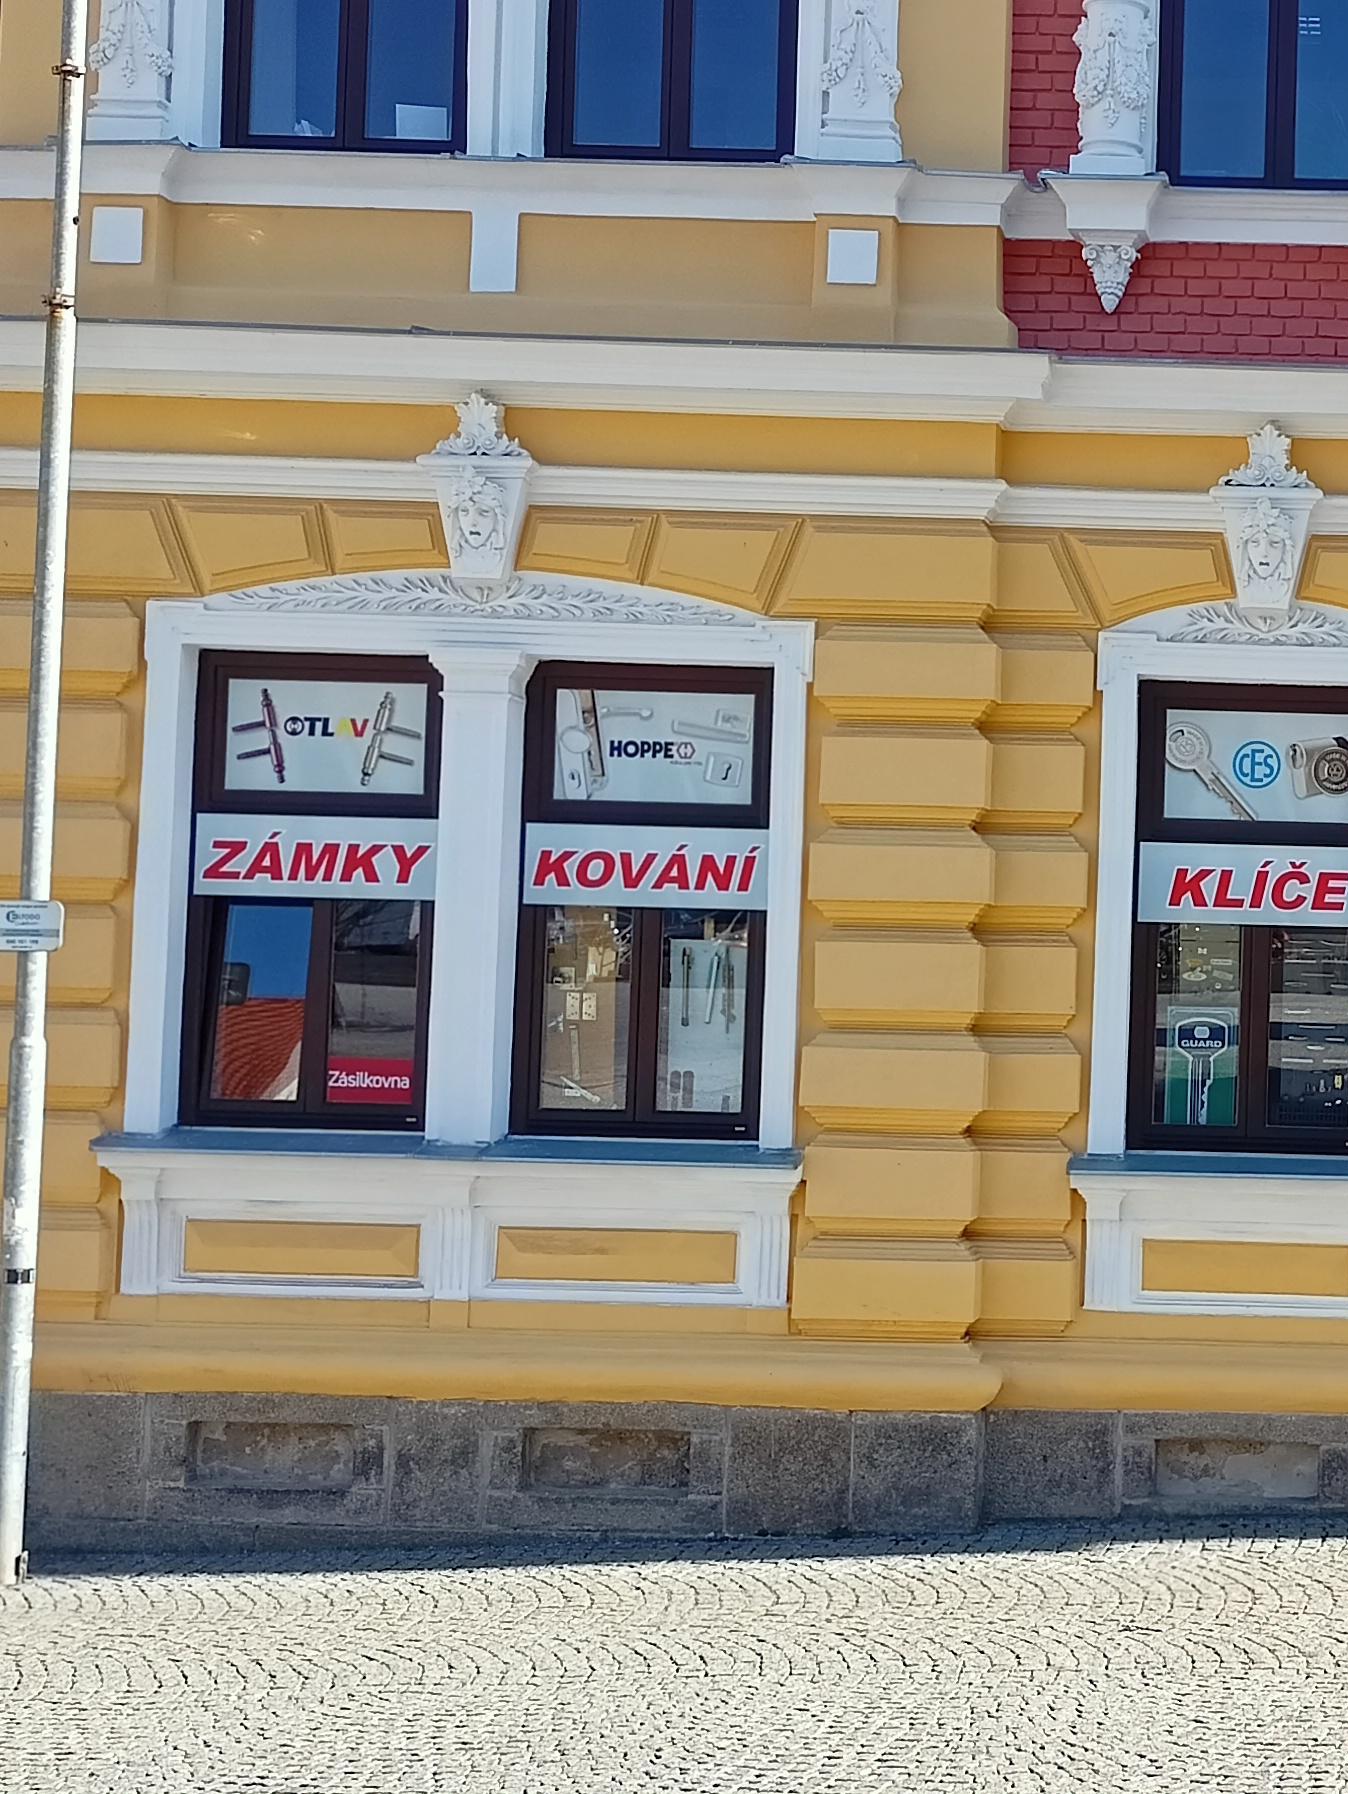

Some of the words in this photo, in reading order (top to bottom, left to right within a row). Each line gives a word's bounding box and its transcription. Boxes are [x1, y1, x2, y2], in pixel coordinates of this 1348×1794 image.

[283, 715, 370, 738] OTLAV
[609, 740, 675, 759] HOPPE
[1238, 748, 1275, 783] CES
[202, 831, 433, 884] ZÁMKY
[532, 843, 761, 892] KOVÁNÍ
[1181, 1039, 1223, 1048] GUARD
[327, 1070, 410, 1089] Zásilkovna
